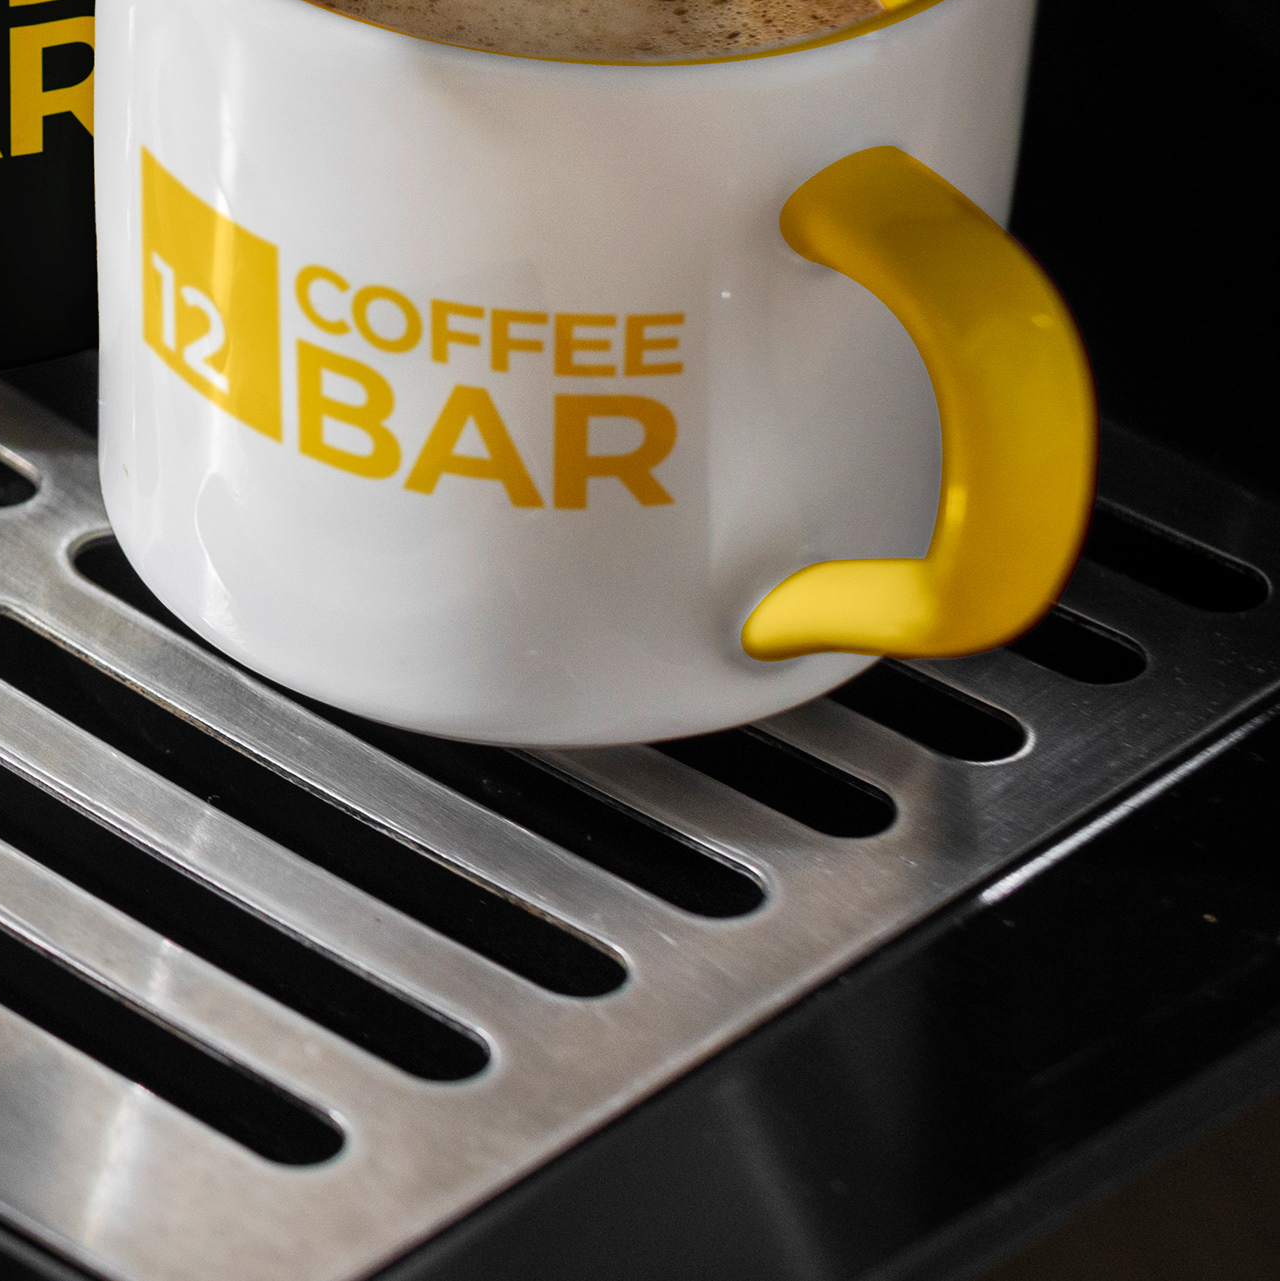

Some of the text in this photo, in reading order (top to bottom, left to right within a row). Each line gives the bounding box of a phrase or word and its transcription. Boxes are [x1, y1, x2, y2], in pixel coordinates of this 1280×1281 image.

[151, 249, 230, 395] 12
[294, 263, 686, 378] COFFEE
[295, 337, 678, 511] BAR
